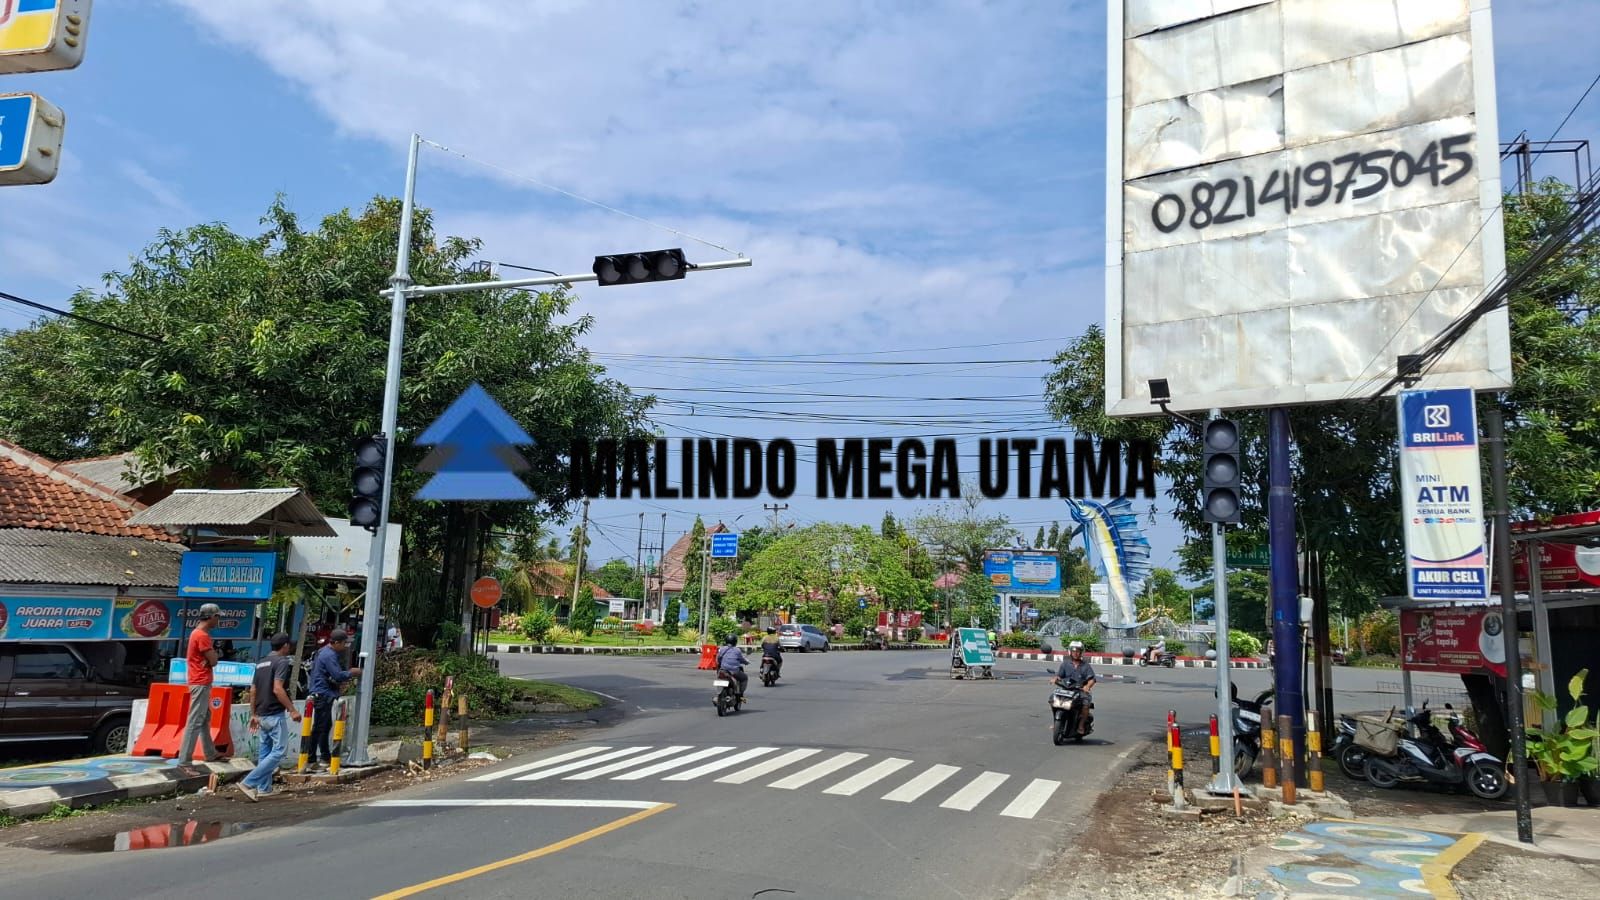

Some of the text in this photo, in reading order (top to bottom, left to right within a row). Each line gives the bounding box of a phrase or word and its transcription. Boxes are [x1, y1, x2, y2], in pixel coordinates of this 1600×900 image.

[1151, 133, 1474, 233] 082141975045
[1412, 432, 1464, 442] BRILink
[1416, 474, 1441, 482] MINI
[1417, 486, 1470, 502] ATM
[199, 566, 264, 583] KARYA BAHARI
[1418, 571, 1480, 583] AKUR CELL
[16, 606, 103, 616] AROMA MANIS
[22, 618, 63, 628] JUARA
[137, 612, 166, 626] JUARA
